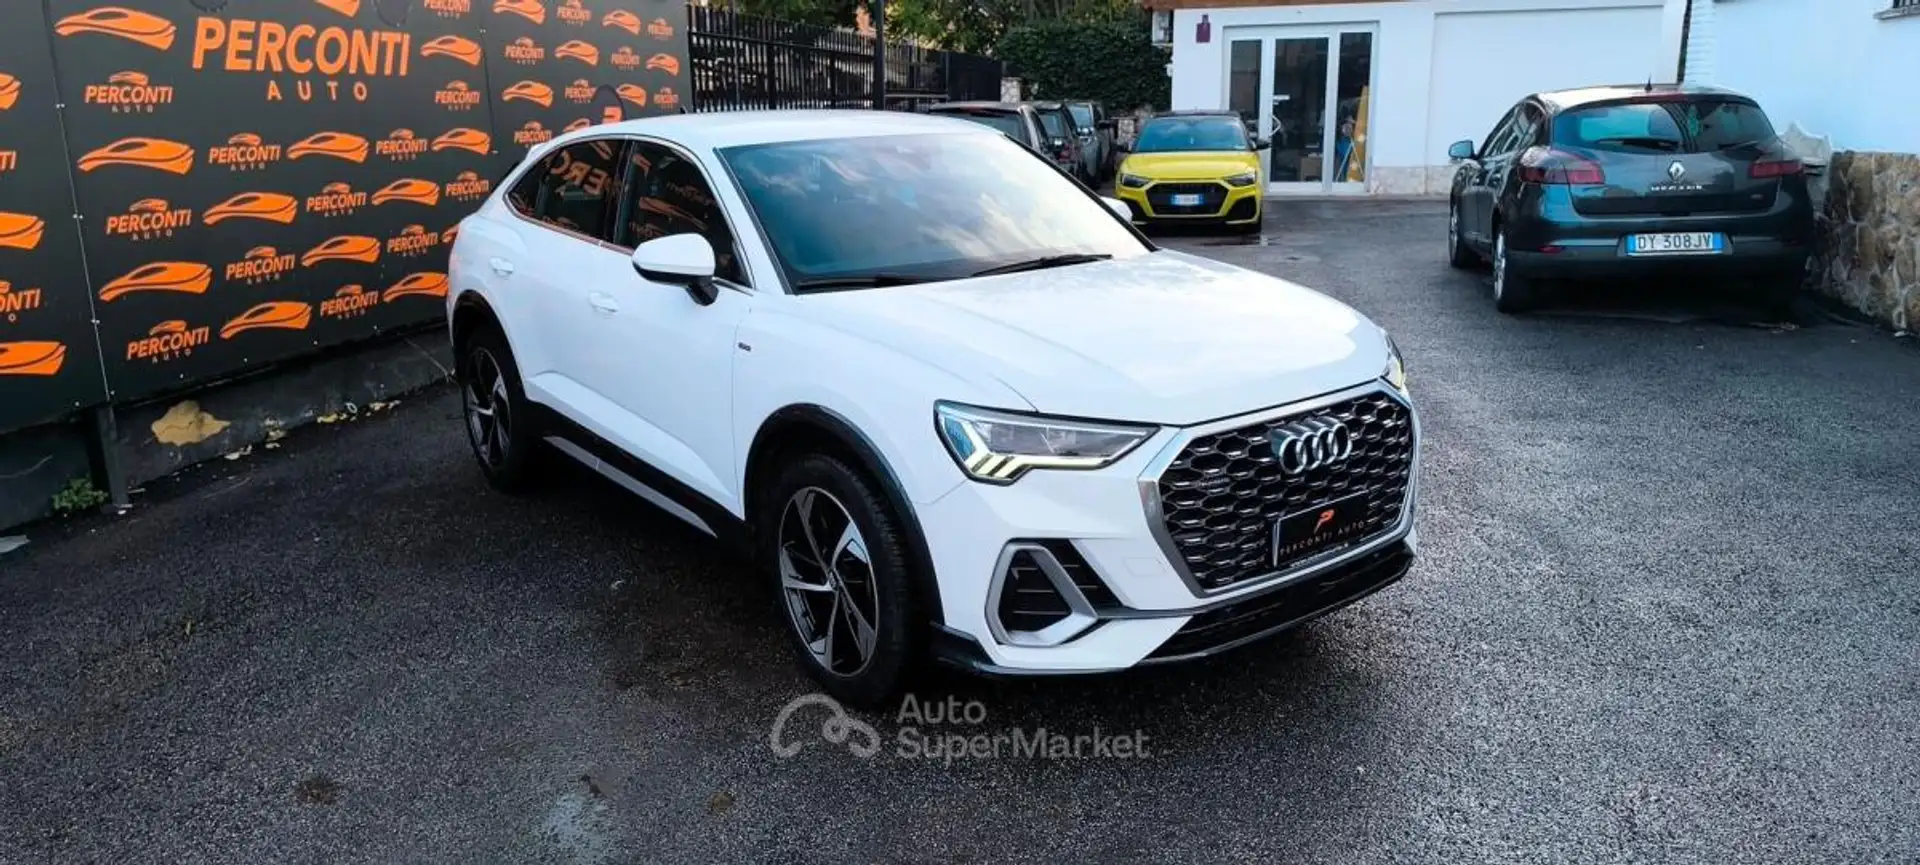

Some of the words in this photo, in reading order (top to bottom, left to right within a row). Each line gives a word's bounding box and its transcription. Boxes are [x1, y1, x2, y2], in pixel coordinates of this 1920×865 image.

[192, 16, 411, 77] PERCONTI
[84, 85, 173, 104] PERCONTI
[267, 79, 368, 101] AUTO
[208, 144, 281, 164] PERCONTI
[106, 208, 192, 235] PERCONTI
[1638, 235, 1656, 249] DY
[1663, 233, 1711, 249] 308JV
[225, 254, 295, 280] PERCONTI
[126, 326, 209, 361] PERCONTI
